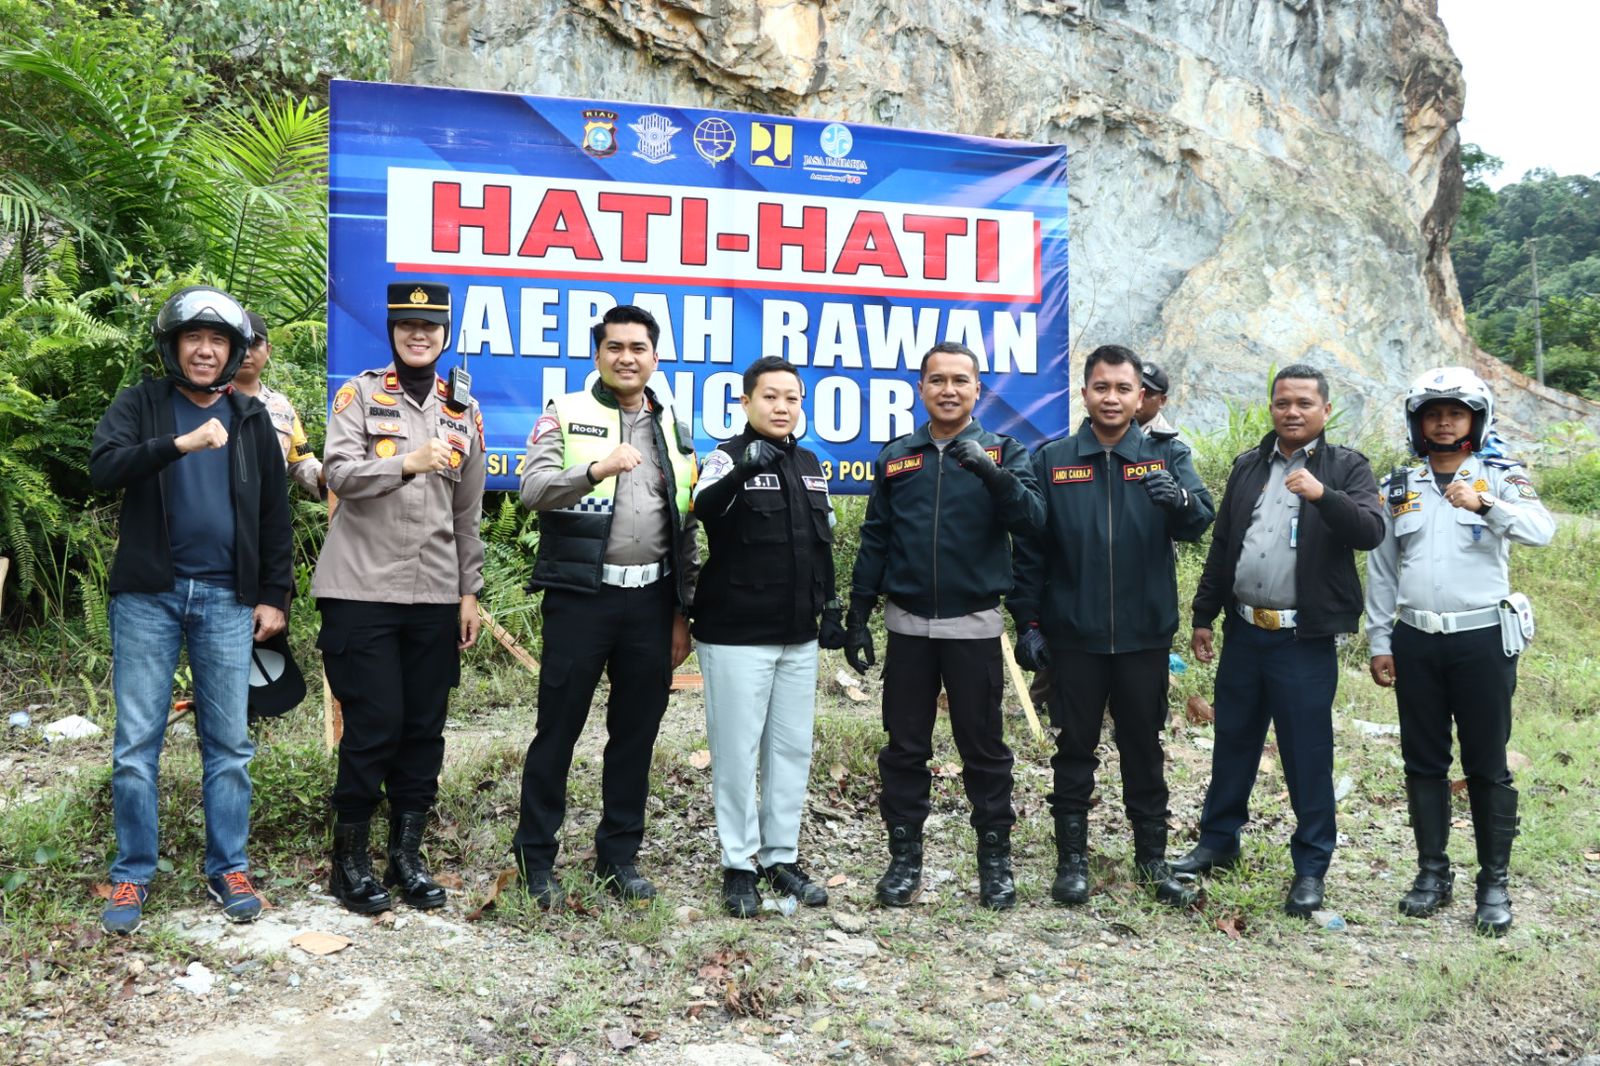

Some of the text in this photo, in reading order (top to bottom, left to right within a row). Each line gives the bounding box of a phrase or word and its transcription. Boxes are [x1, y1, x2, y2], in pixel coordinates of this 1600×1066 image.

[585, 110, 615, 119] RIAU
[803, 154, 825, 167] JASA
[431, 180, 1001, 283] HATI-HATI
[447, 284, 1038, 375] AERAH RAWAN
[542, 366, 915, 444] NGOR
[439, 417, 468, 435] POLRI
[571, 423, 605, 436] Rocky
[487, 453, 507, 475] SI
[515, 454, 527, 475] Z
